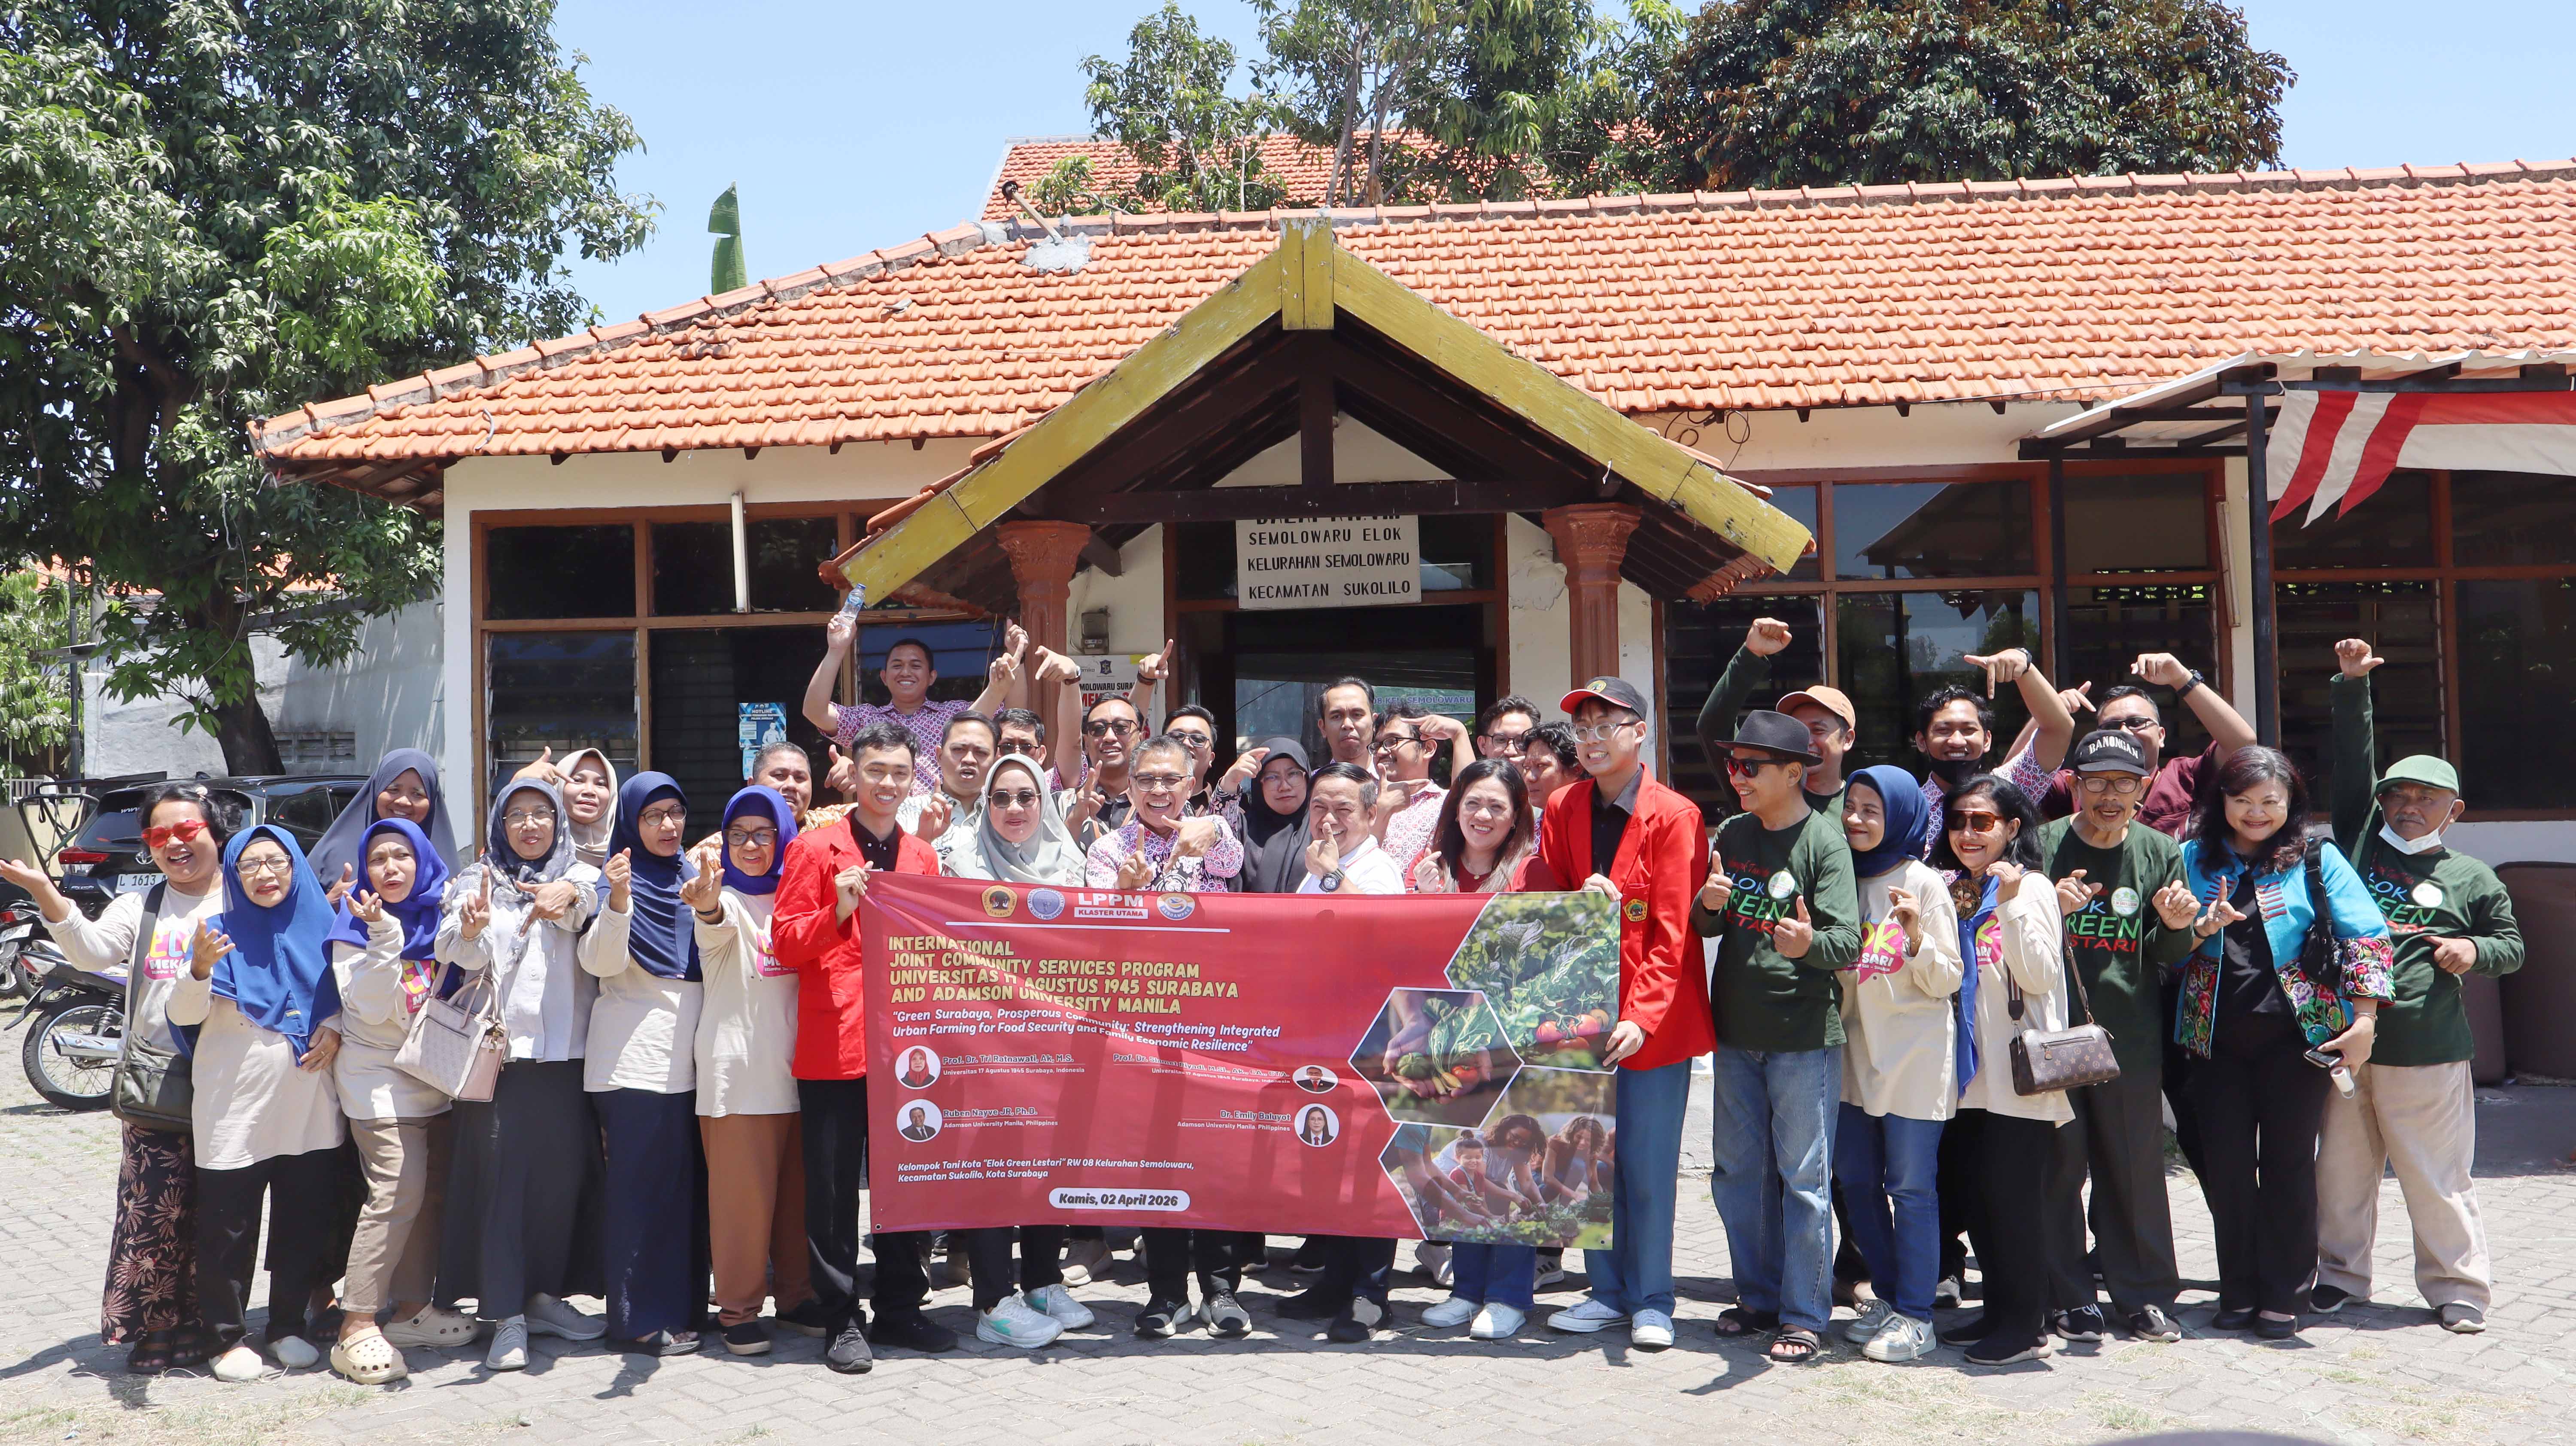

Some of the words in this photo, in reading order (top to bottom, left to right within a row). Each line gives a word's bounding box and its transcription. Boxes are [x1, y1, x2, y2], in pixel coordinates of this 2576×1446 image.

[1249, 529, 1351, 545] SEMOLOWARU
[1363, 527, 1402, 541] ELOK
[1248, 556, 1320, 571] KELURAHAN
[1325, 552, 1410, 568] SEMOLOWARU
[1249, 583, 1329, 599] KECAMATAN
[1344, 580, 1410, 595] SUKOLILO
[2088, 735, 2139, 759] BANONGAN
[120, 876, 125, 886] L
[131, 875, 156, 886] 1613
[1078, 893, 1144, 907] LPPM
[1724, 889, 1790, 922] REEN
[2066, 913, 2141, 939] REEN
[888, 936, 1015, 956] INTERNATIONAL
[1861, 921, 1899, 955] OK
[2070, 934, 2137, 953] STARI
[1862, 952, 1895, 967] SARI
[1975, 946, 1992, 957] ARI
[889, 953, 936, 967] JOINT
[942, 952, 1032, 974] COMMUNITY
[1038, 959, 1116, 975] SERVICES
[1121, 962, 1200, 978] PROGRAM
[890, 968, 999, 985] UNIVERSITAS
[1003, 972, 1018, 984] 17
[1025, 977, 1099, 993] AGUSTUS
[1104, 978, 1139, 994] 1945
[1146, 980, 1239, 998] SURABAYA
[891, 987, 926, 1003] AND
[932, 985, 1013, 1001] ADAMSON
[1019, 987, 1112, 1012] UNIVERSITY
[1117, 997, 1182, 1014] MANILA
[893, 1011, 931, 1022] "Green
[935, 1009, 993, 1021] Surabaya,
[997, 1009, 1061, 1021] Prosperous
[1065, 1011, 1130, 1032] Community:
[1134, 1021, 1216, 1037] Strengthening
[1220, 1024, 1281, 1039] Integrated
[893, 1025, 927, 1037] Urban
[929, 1023, 976, 1036] Farming
[978, 1022, 996, 1033] for
[997, 1022, 1025, 1033] Food
[1027, 1022, 1074, 1035] Security
[1076, 1024, 1097, 1033] and
[1099, 1027, 1134, 1042] Family
[1136, 1035, 1189, 1049] Economic
[1191, 1039, 1253, 1052] Resilience"
[942, 1056, 964, 1065] Prof.
[965, 1055, 978, 1063] Dr.
[993, 1054, 1039, 1063] Ratnawati,
[1113, 1054, 1135, 1062] Prof.
[1136, 1055, 1149, 1063] Dr.
[943, 1109, 970, 1117] Ruben
[972, 1109, 998, 1118] Nayve
[999, 1107, 1014, 1117] JR,
[1015, 1107, 1038, 1115] Ph.D.
[1221, 1110, 1233, 1119] Dr.
[1234, 1111, 1258, 1121] Emily
[1258, 1112, 1291, 1122] Baluyot
[1206, 1122, 1236, 1130] University
[1258, 1124, 1291, 1132] Philippines
[897, 1161, 940, 1172] Kelompok
[942, 1160, 960, 1169] Tani
[961, 1160, 981, 1168] Kota
[983, 1159, 1005, 1167] "Elok
[1006, 1159, 1031, 1167] Green
[1033, 1158, 1066, 1167] Lestari"
[1066, 1158, 1082, 1167] RW
[1095, 1159, 1138, 1168] Kelurahan
[1139, 1160, 1194, 1170] Semolowaru,
[898, 1173, 947, 1182] Kecamatan
[948, 1170, 984, 1180] Sukolilo,
[985, 1170, 1006, 1178] Kota
[1007, 1169, 1048, 1179] Surabaya
[1059, 1193, 1098, 1206] Kamis,
[1100, 1194, 1116, 1205] 02
[1118, 1194, 1147, 1207] April
[1148, 1195, 1179, 1206] 2026
